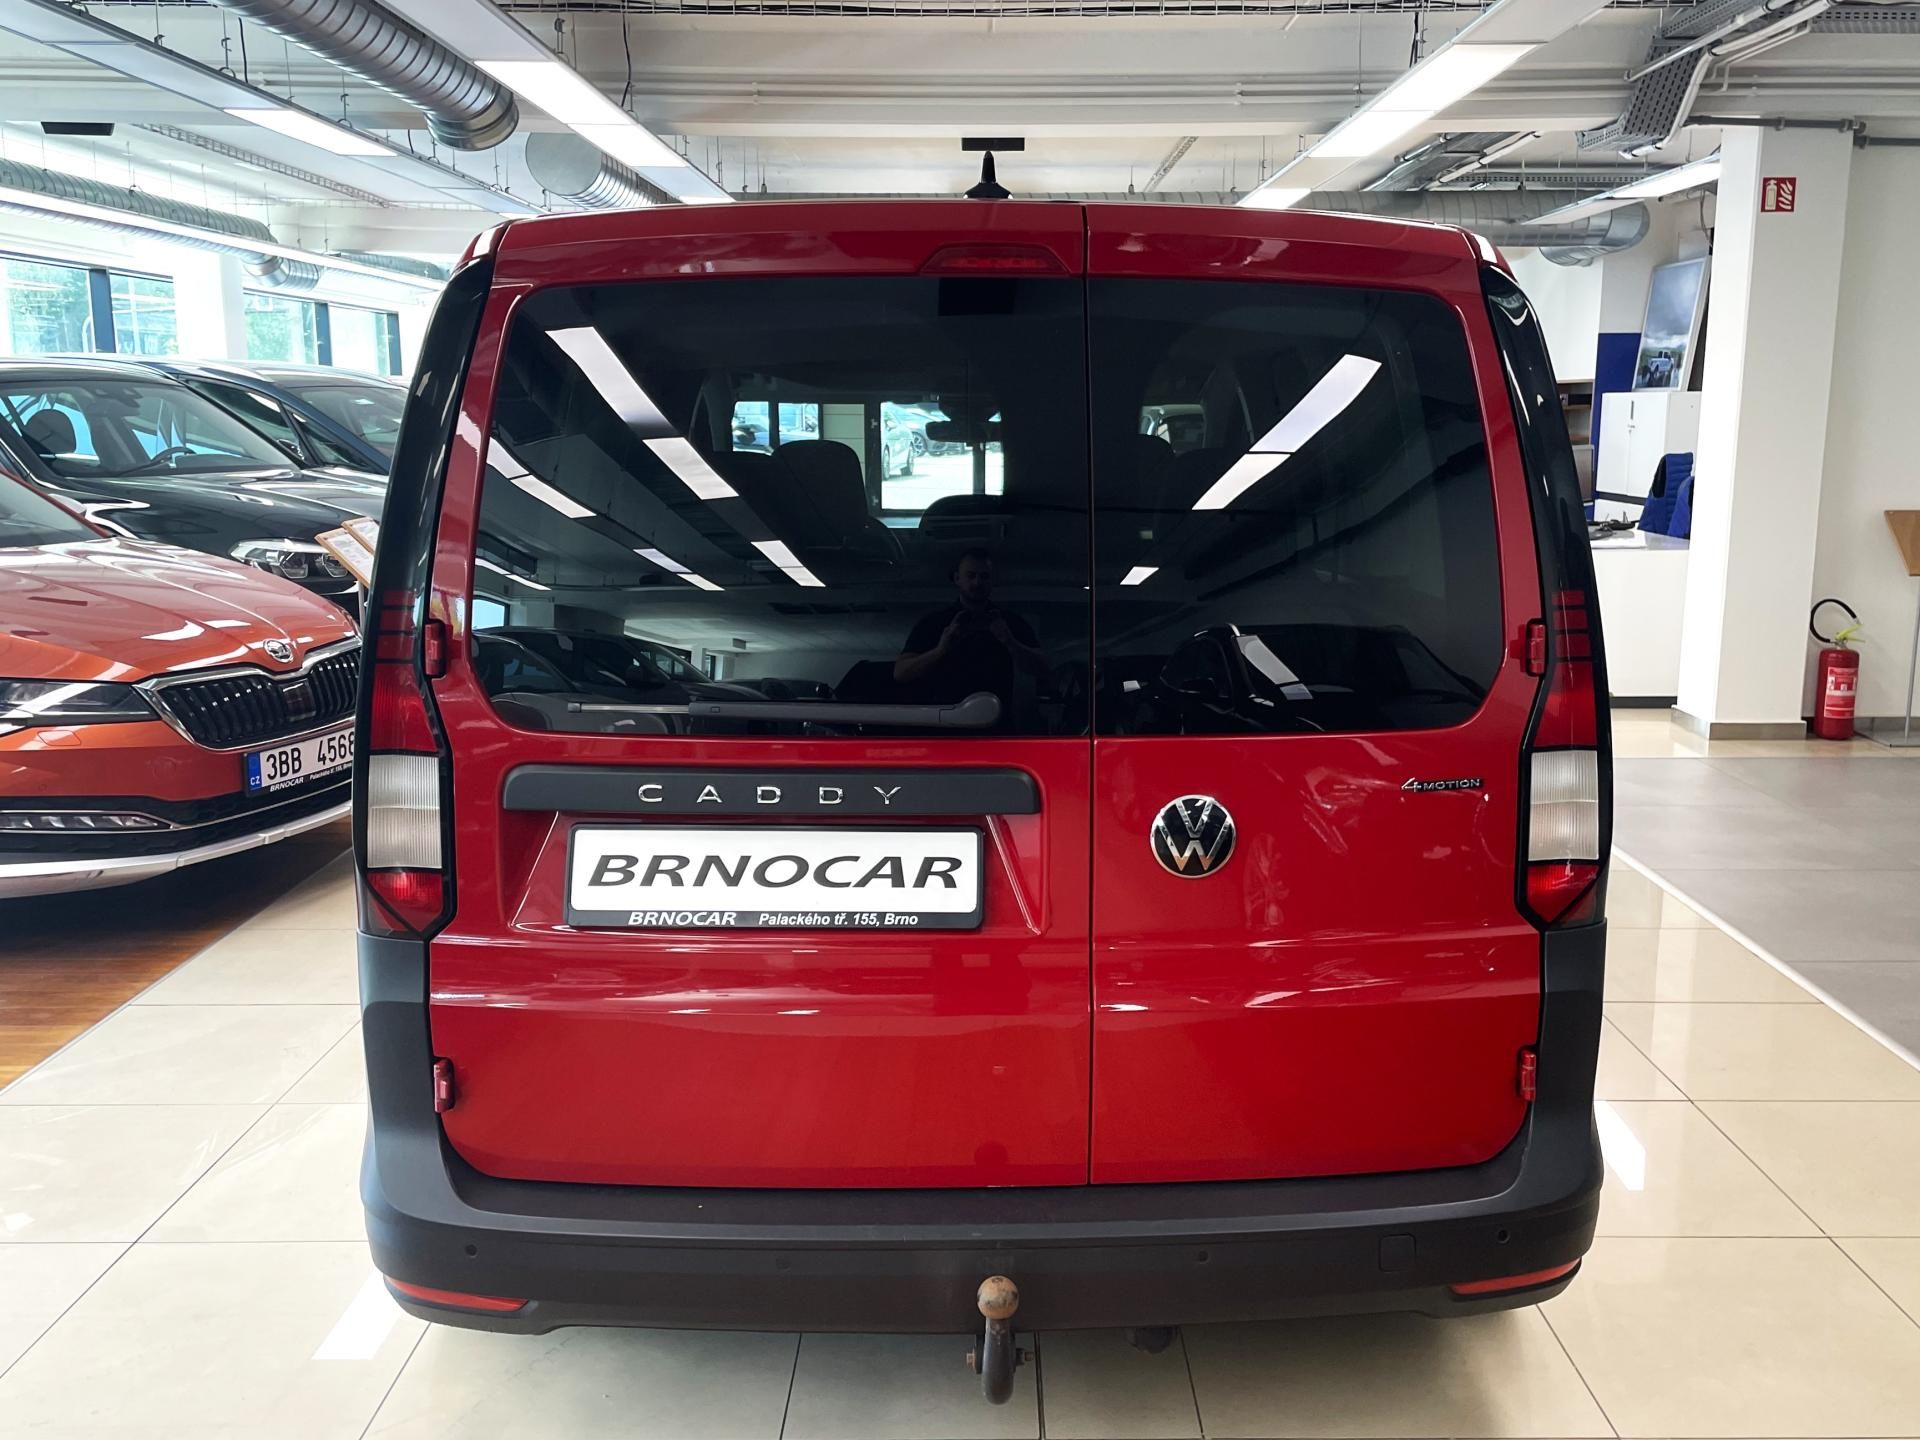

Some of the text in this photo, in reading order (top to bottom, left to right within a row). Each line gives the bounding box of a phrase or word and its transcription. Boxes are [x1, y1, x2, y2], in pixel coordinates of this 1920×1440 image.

[266, 747, 302, 780] 3BB
[250, 775, 261, 786] CZ
[269, 777, 304, 792] BRNOCAR
[1401, 777, 1480, 793] 4MOTION
[638, 784, 901, 805] CADDY
[588, 854, 963, 889] BRNOCAR
[628, 911, 918, 927] BRNOCAR Palackého tř. 155, Brno
